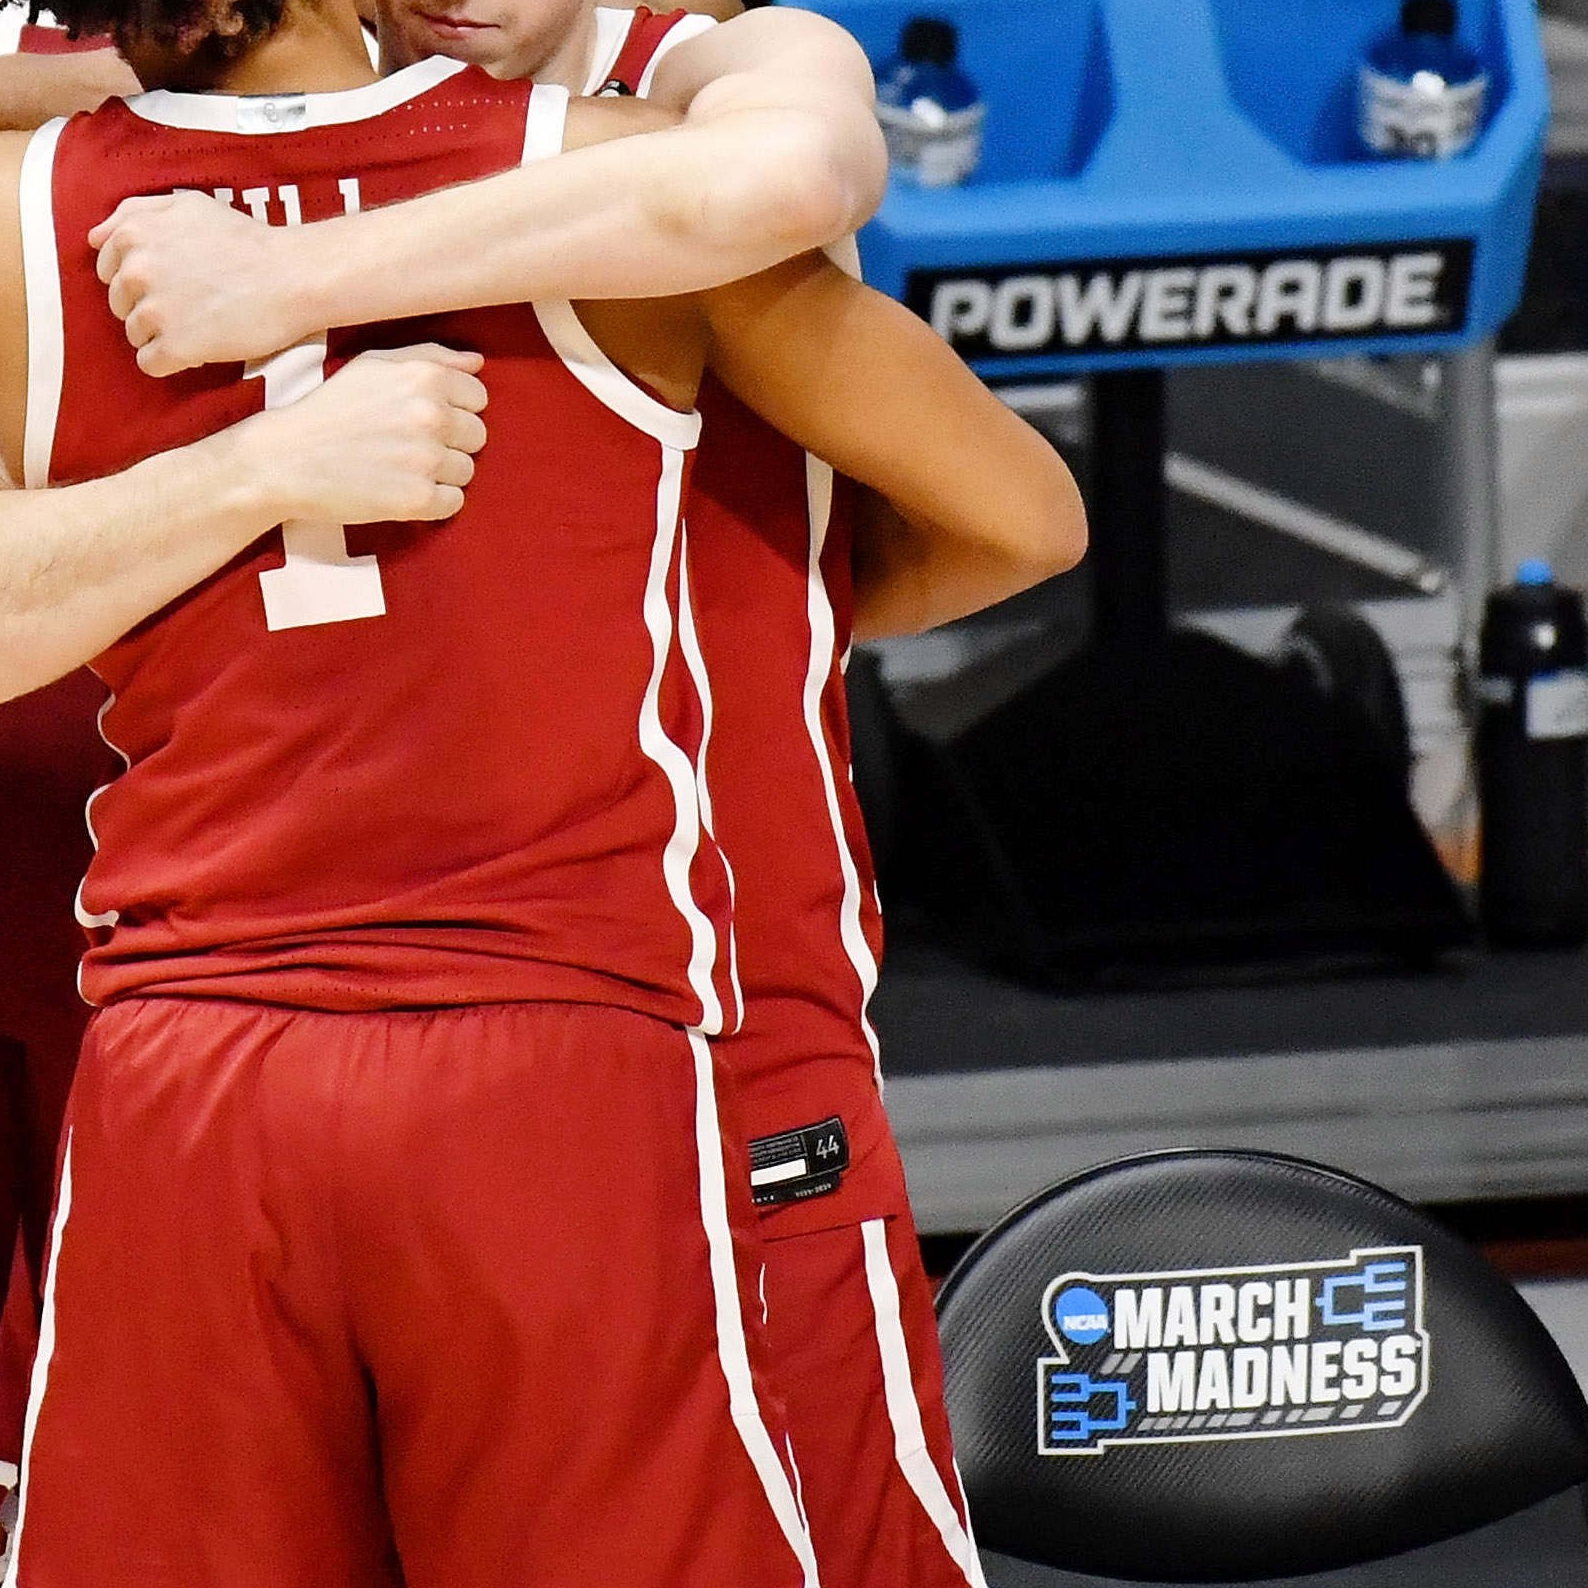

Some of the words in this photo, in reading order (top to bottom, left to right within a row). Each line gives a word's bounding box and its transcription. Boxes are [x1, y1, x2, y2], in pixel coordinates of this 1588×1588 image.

[930, 253, 1445, 352] POWERADE
[815, 1134, 840, 1160] 44
[1063, 1314, 1109, 1331] NCAA
[1113, 1279, 1312, 1351] MARCH
[1146, 1335, 1417, 1412] MADNESS
